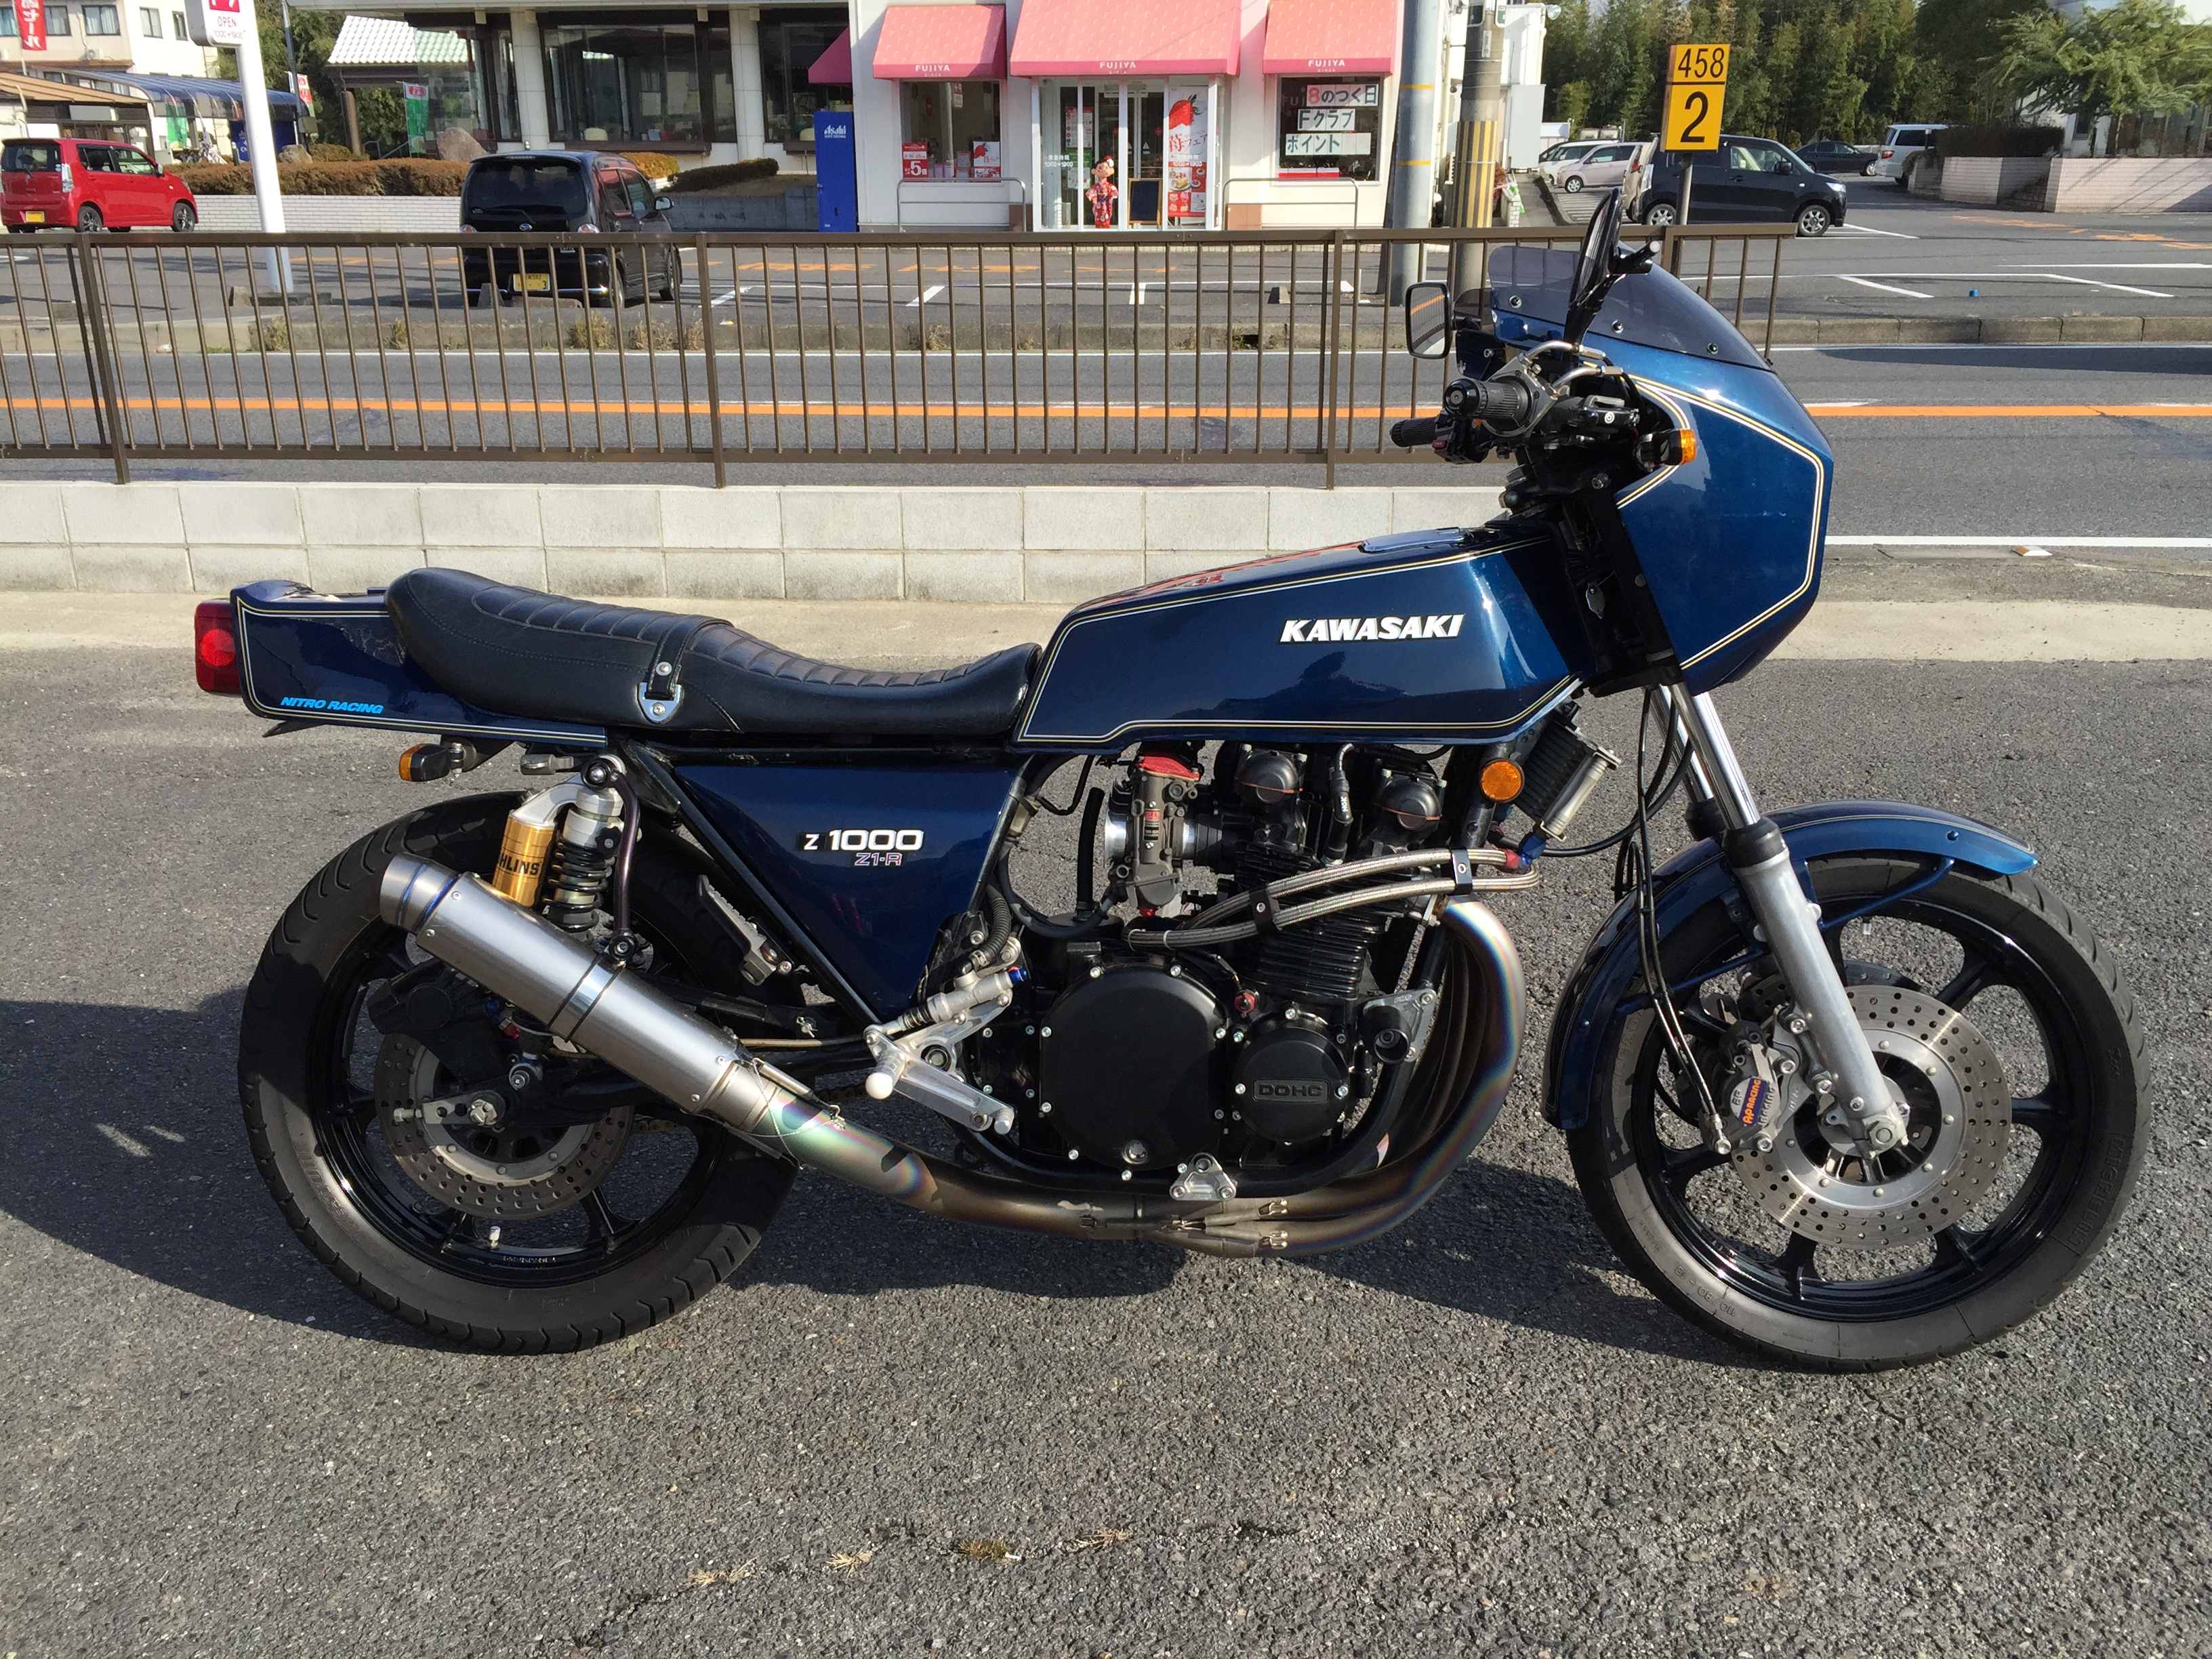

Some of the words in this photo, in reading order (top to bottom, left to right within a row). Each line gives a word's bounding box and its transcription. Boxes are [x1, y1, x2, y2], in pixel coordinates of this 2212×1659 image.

[218, 16, 237, 27] OPEN
[1100, 61, 1136, 69] FUJIYA
[1308, 59, 1345, 67] FUJIYA
[1677, 47, 1725, 79] 458
[1307, 85, 1377, 104] 8のつく日
[1298, 110, 1353, 129] Fクラブ
[1680, 91, 1709, 143] 2
[1287, 134, 1340, 153] ポイント
[1279, 613, 1466, 642] KAWASAKI
[280, 697, 327, 709] NITRO
[327, 701, 384, 714] RACING
[1340, 796, 1349, 812] NGK
[804, 834, 820, 850] Z
[829, 829, 924, 851] 1000
[498, 853, 541, 876] HLINS
[1259, 1084, 1323, 1097] DOHC
[1746, 1079, 1761, 1109] RACING
[2067, 1138, 2125, 1247] MICHELIN
